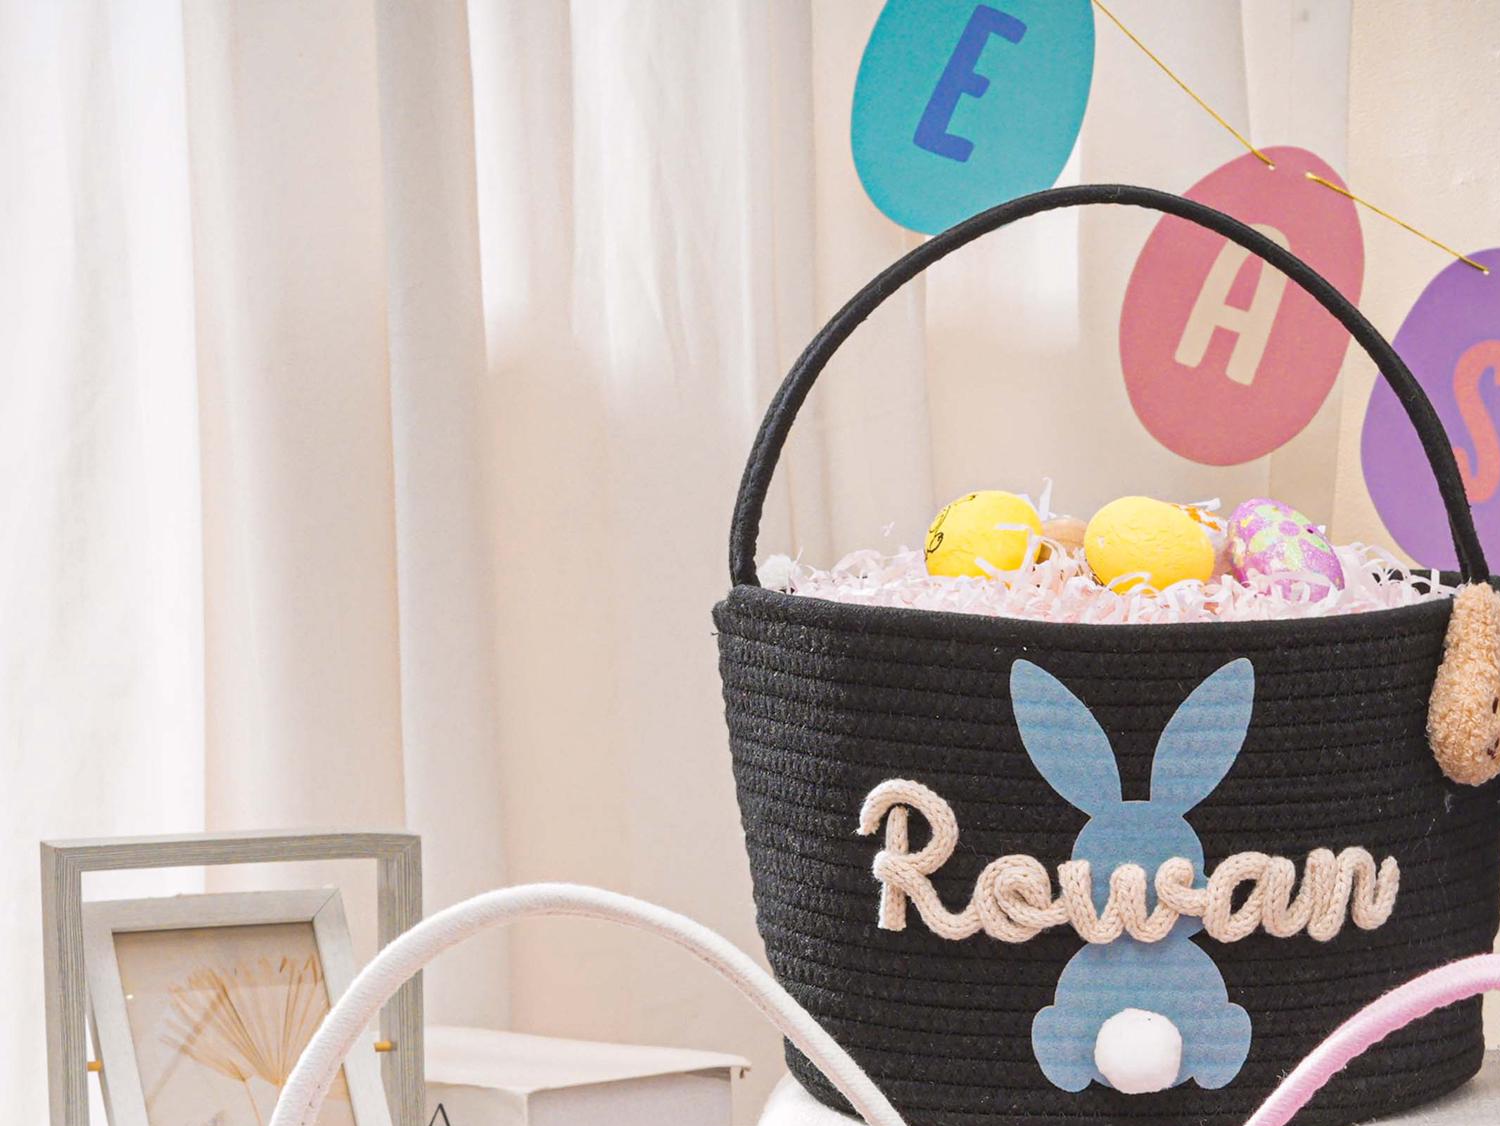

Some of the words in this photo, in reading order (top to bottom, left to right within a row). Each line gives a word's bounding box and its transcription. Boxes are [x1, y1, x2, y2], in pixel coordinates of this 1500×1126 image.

[913, 4, 1028, 164] E
[1174, 223, 1291, 386] A
[857, 777, 1400, 944] Rowan
